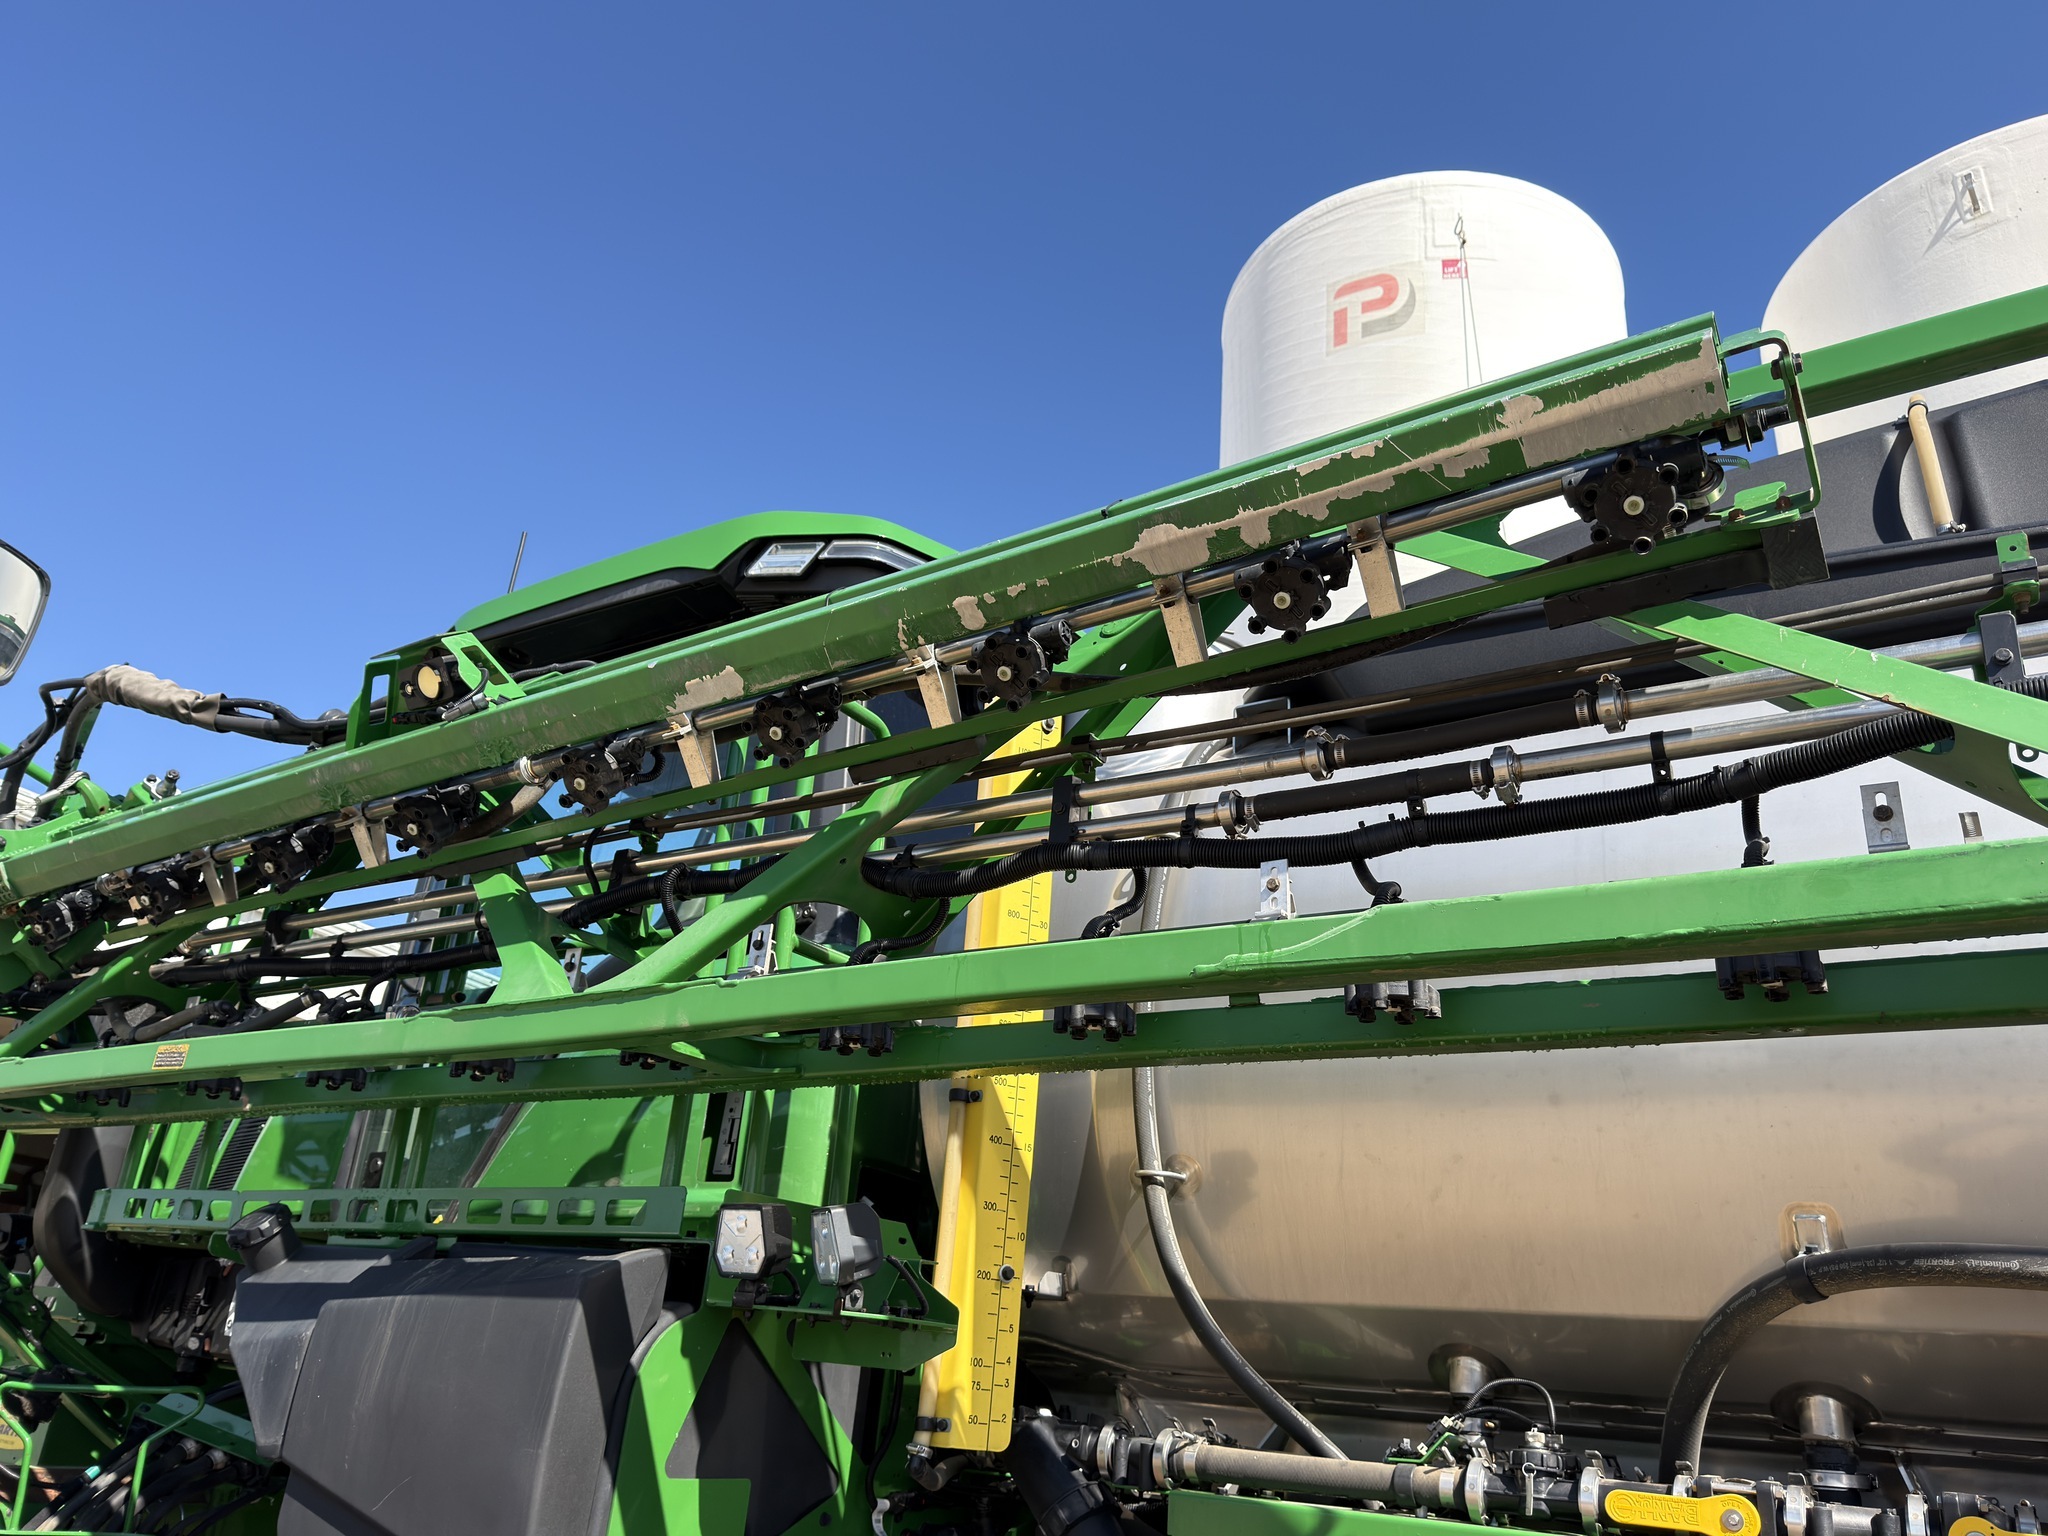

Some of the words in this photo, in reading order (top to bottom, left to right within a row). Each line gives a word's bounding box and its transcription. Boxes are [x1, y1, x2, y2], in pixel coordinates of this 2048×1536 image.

[1007, 909, 1020, 919] 800
[1040, 921, 1049, 930] 30
[993, 1076, 1008, 1086] 500
[989, 1134, 1003, 1145] 400
[1024, 1143, 1033, 1153] 15
[983, 1200, 997, 1211] 300
[1016, 1232, 1026, 1242] 10
[1913, 1258, 1955, 1267] FRONTIER
[1971, 1259, 2020, 1270] Continental
[976, 1269, 991, 1281] 200
[1009, 1324, 1014, 1333] 5
[970, 1357, 984, 1368] 100
[1006, 1356, 1011, 1366] 4
[971, 1380, 981, 1391] 75
[1004, 1378, 1010, 1388] 3
[968, 1414, 979, 1425] 50
[1001, 1413, 1007, 1423] 2
